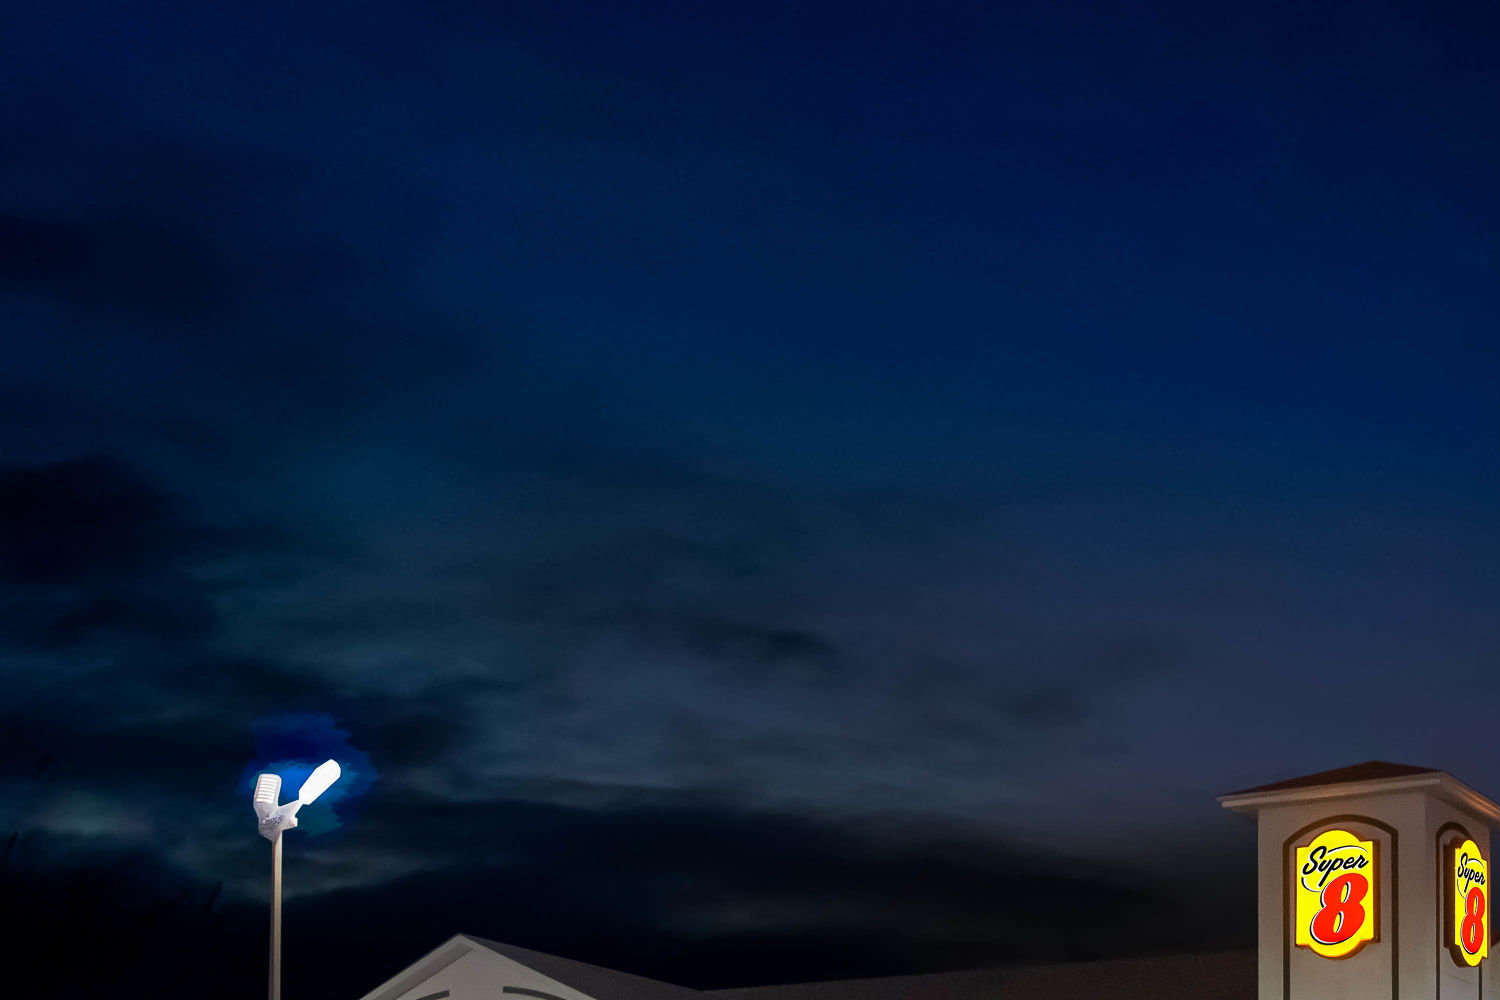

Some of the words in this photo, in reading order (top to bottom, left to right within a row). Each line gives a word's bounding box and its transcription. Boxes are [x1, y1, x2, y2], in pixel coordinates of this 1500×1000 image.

[1302, 846, 1369, 888] Super
[1457, 852, 1486, 893] Super
[1310, 873, 1369, 945] 8
[1461, 886, 1486, 955] 8
